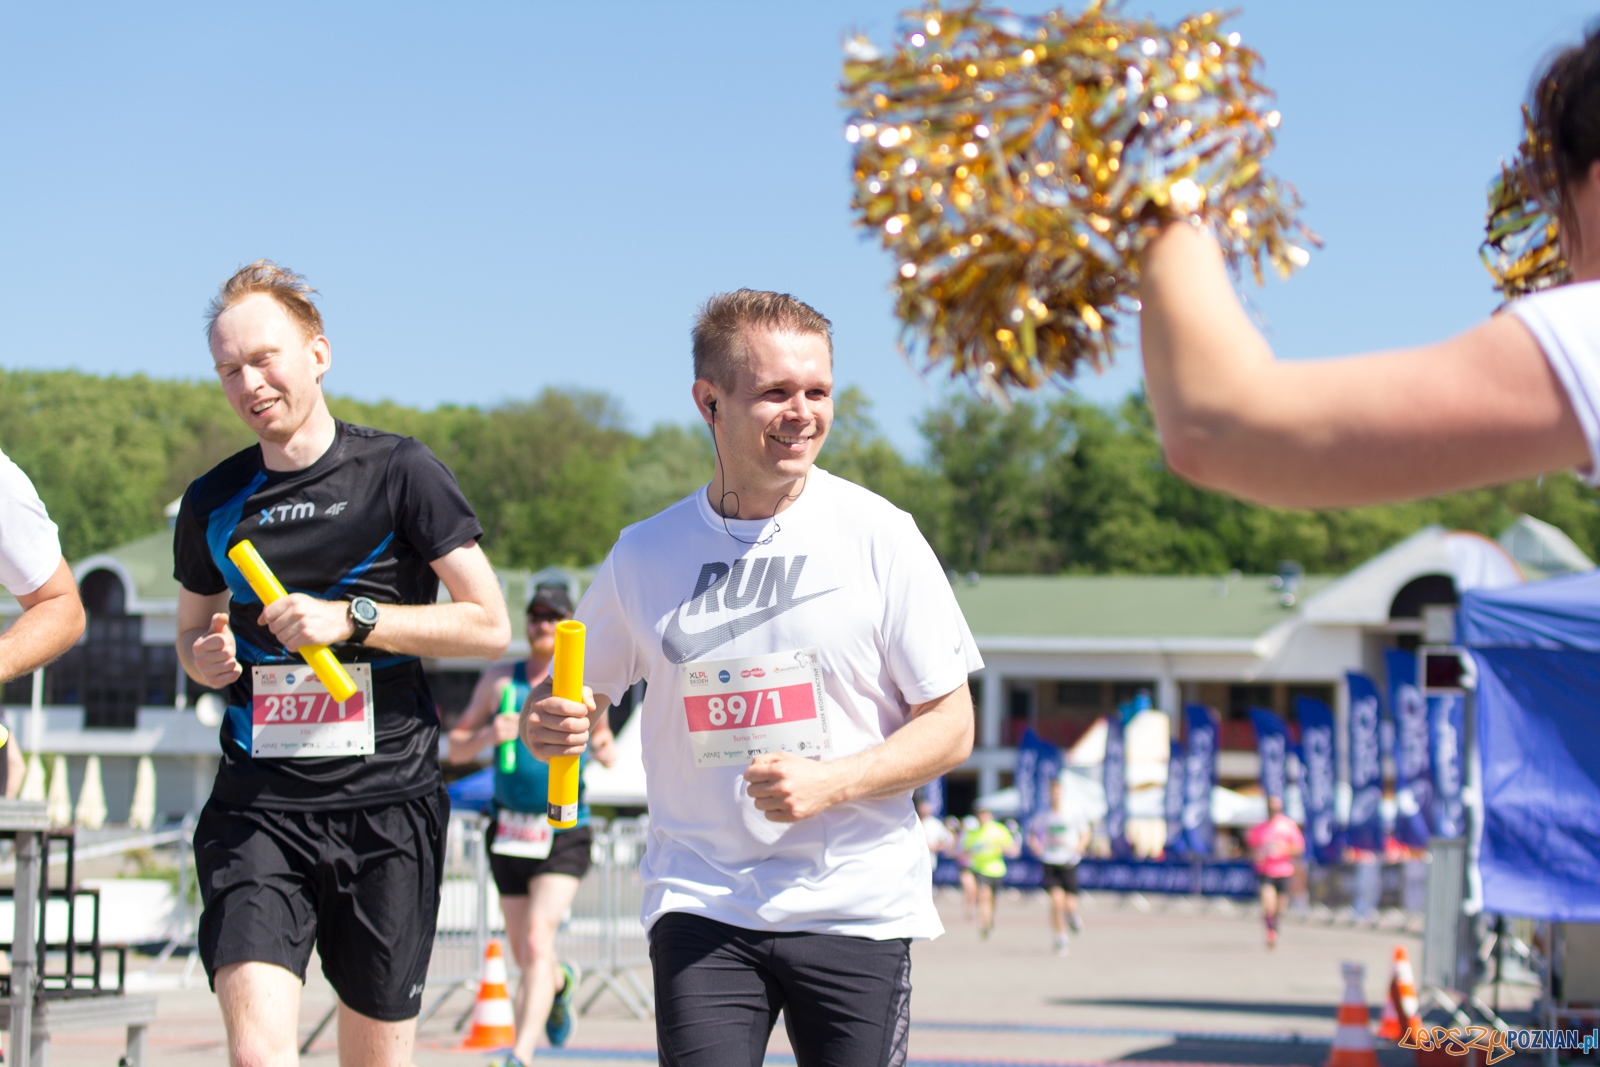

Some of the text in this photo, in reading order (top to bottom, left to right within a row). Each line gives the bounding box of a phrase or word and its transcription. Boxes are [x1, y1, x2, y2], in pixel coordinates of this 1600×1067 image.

[324, 500, 349, 516] 4F
[685, 554, 809, 617] RUN
[264, 694, 347, 722] 287/1
[707, 690, 783, 726] 89/1
[751, 733, 768, 741] Team
[702, 751, 721, 759] APART
